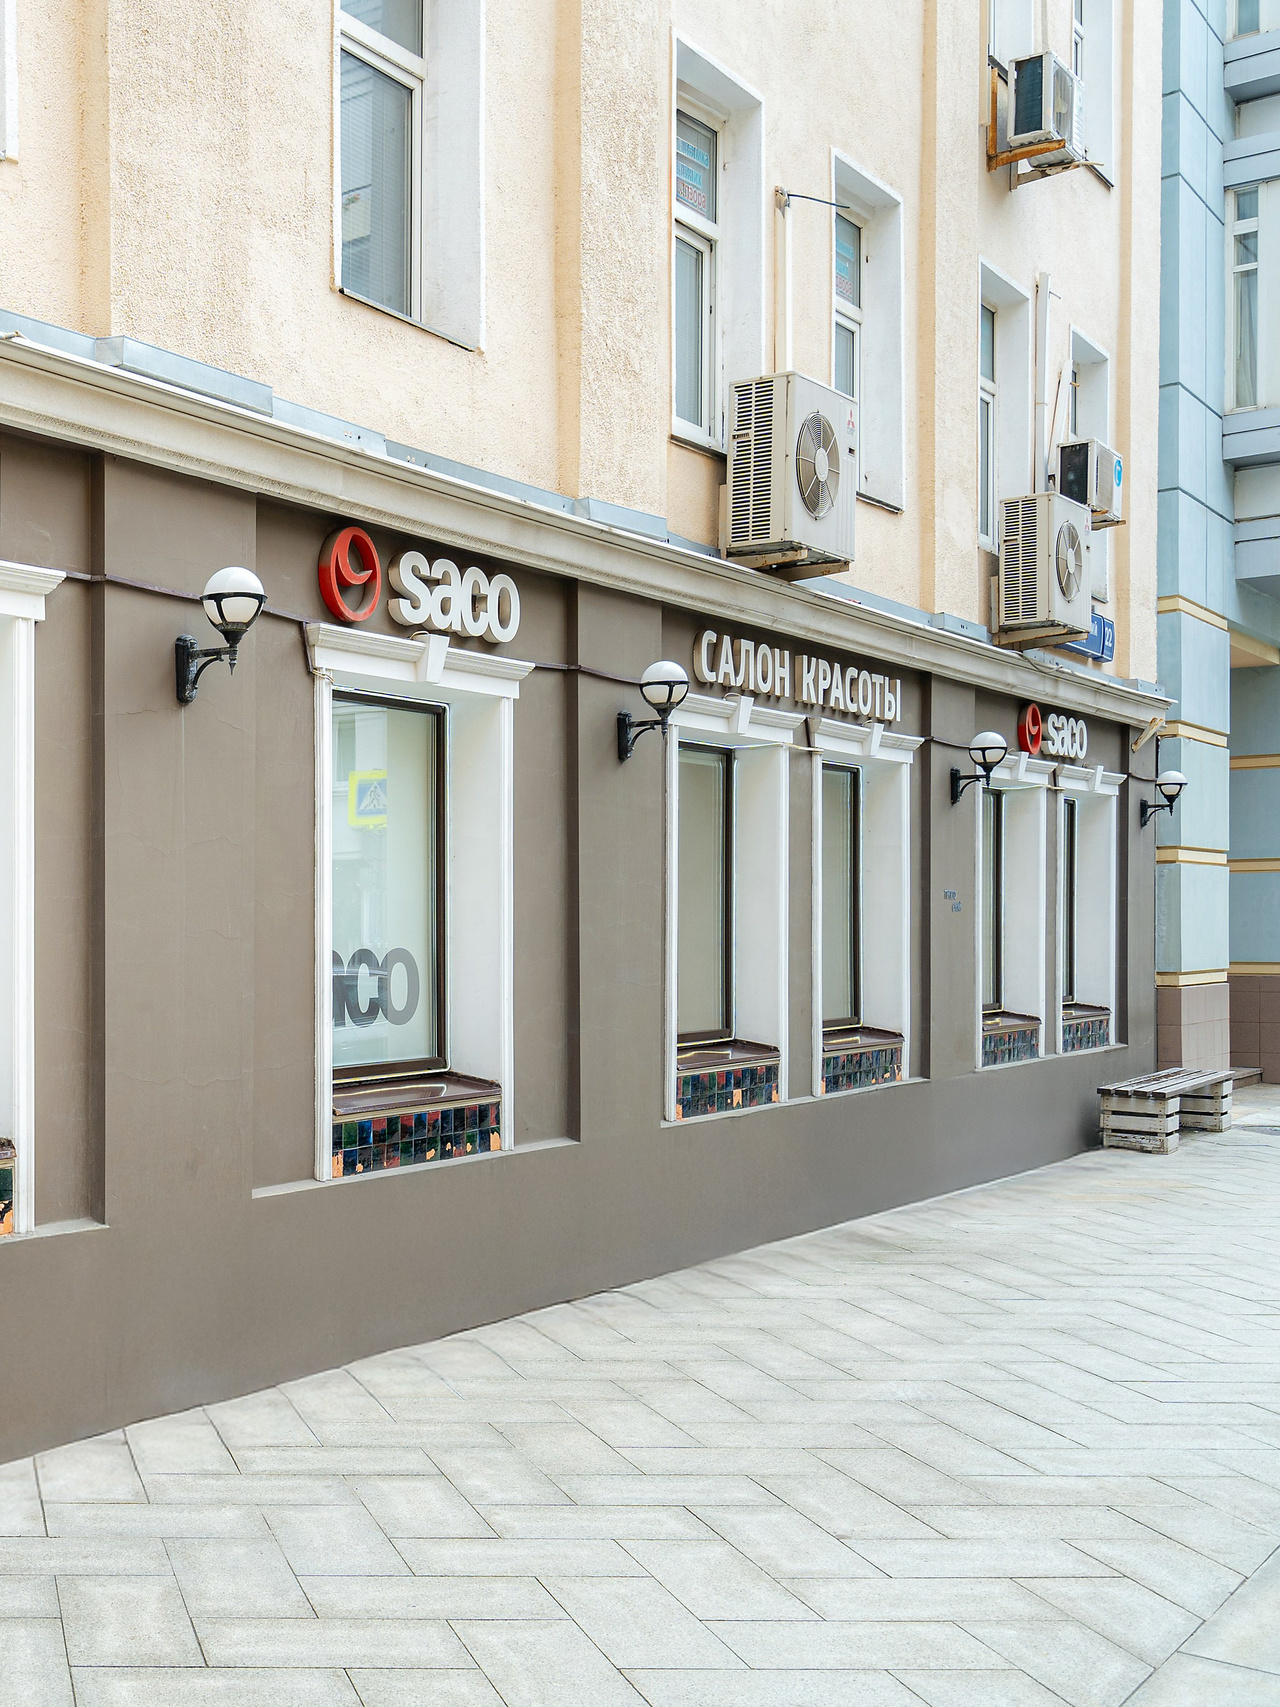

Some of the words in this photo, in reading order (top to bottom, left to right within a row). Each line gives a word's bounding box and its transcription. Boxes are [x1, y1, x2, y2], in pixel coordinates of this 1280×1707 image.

[387, 551, 521, 643] saco
[693, 629, 790, 698] САЛОН
[794, 654, 901, 722] КРАСОТЫ
[1041, 712, 1088, 760] saco
